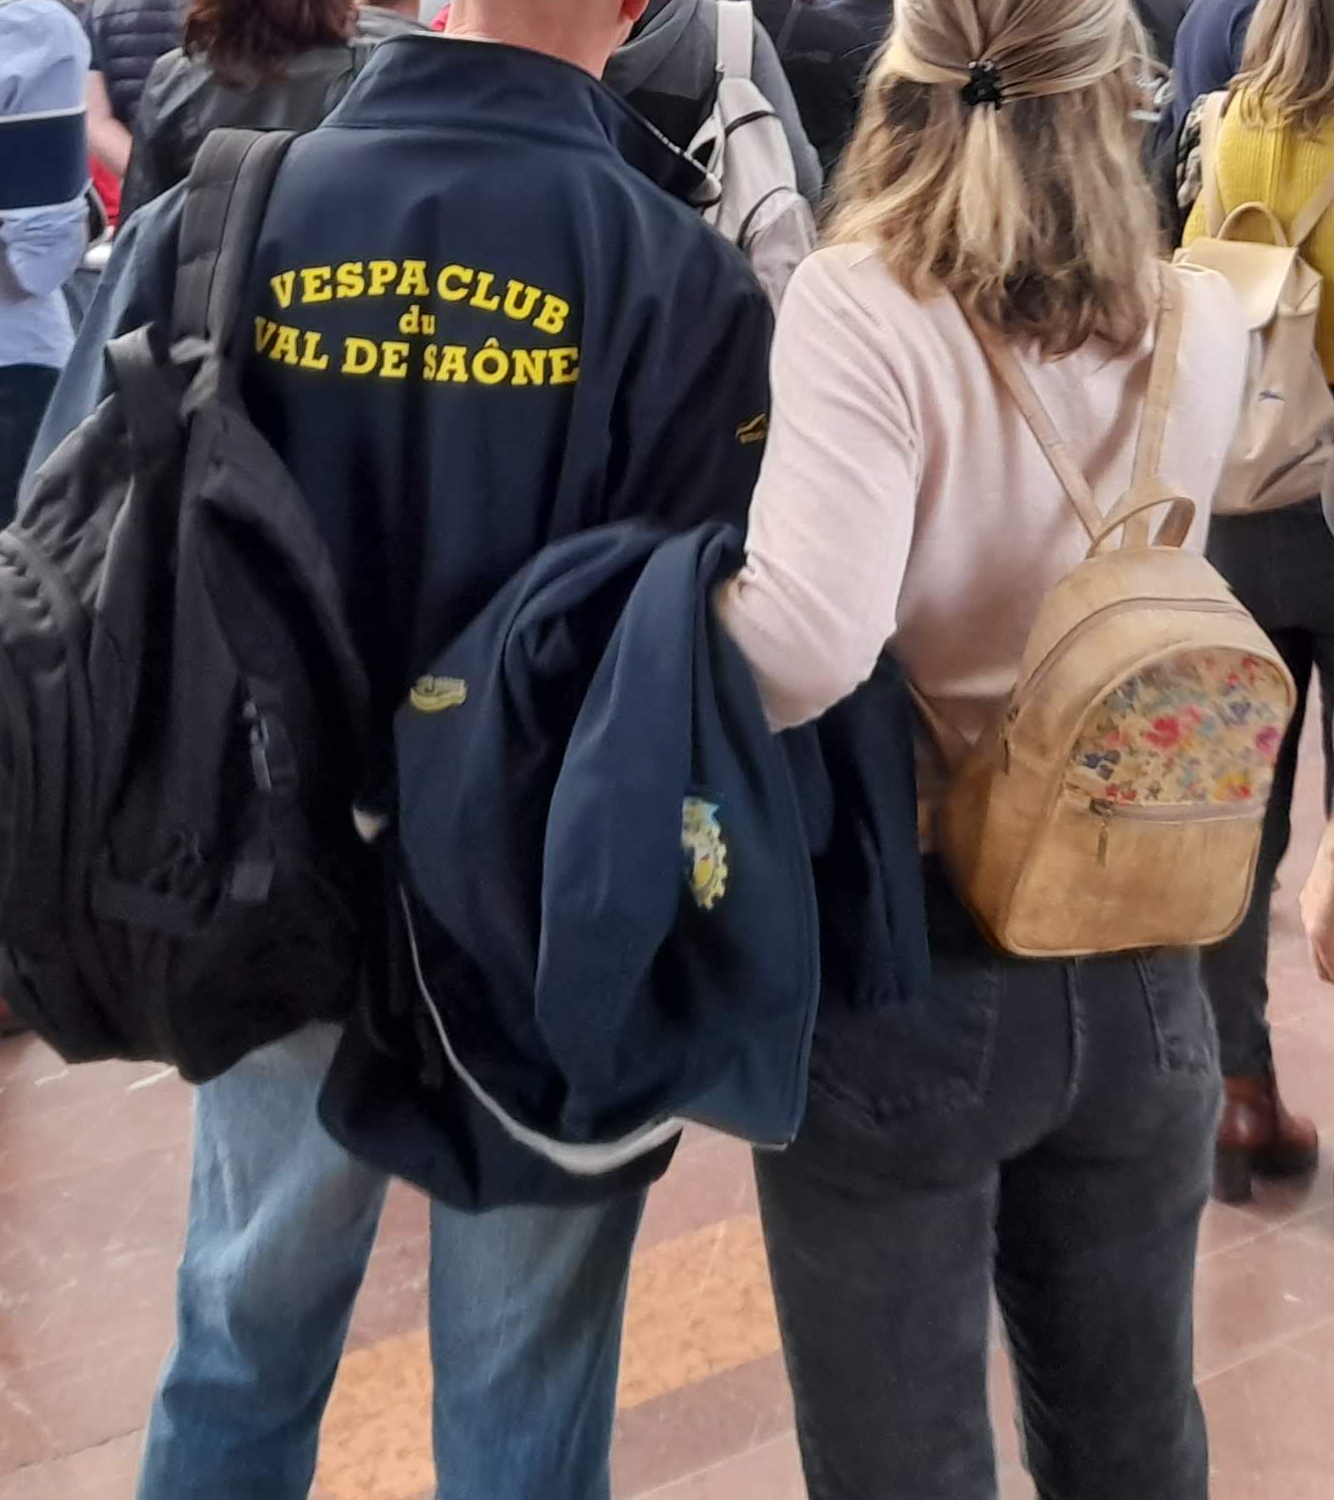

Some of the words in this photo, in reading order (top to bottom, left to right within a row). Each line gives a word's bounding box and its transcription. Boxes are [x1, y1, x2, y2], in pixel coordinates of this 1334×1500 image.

[270, 259, 430, 309] VESPA
[437, 264, 570, 334] CLUB
[399, 304, 436, 335] du
[255, 315, 329, 370] VAL
[341, 337, 410, 378] DE
[423, 336, 579, 386] SAÔNE
